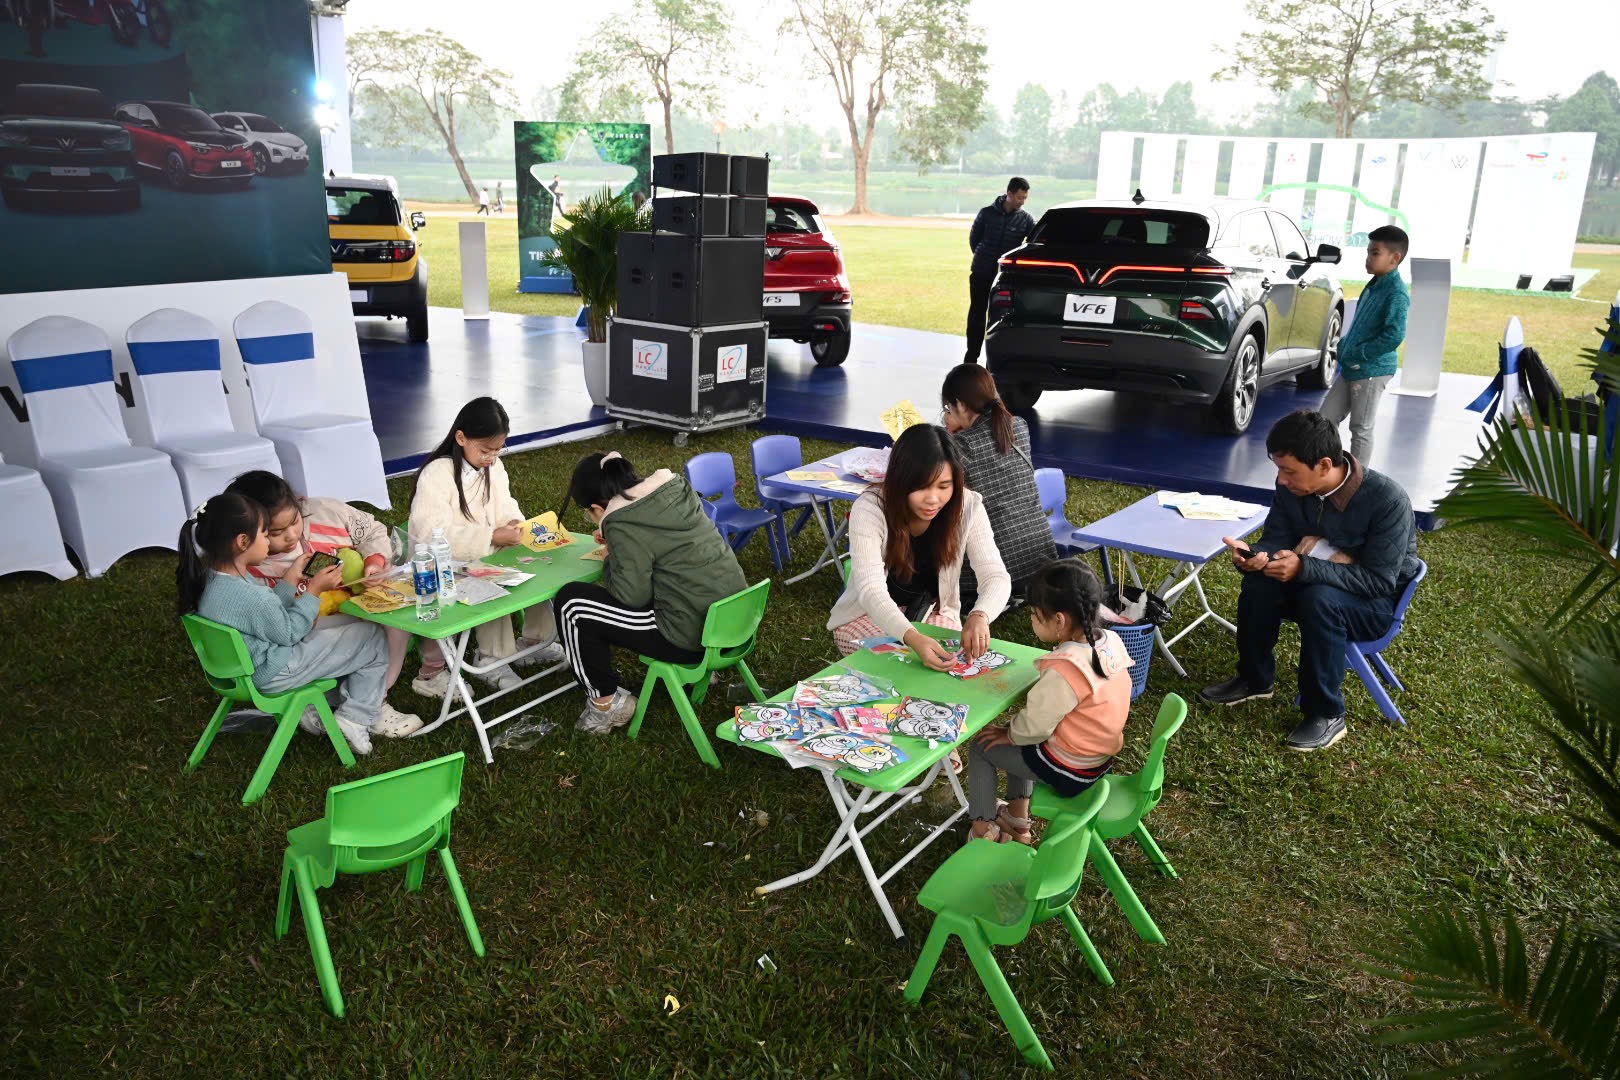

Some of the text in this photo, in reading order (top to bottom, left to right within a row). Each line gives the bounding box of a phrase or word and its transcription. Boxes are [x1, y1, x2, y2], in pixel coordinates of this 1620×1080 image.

[1072, 302, 1108, 315] VF6
[638, 351, 652, 365] LC
[721, 357, 734, 370] LC
